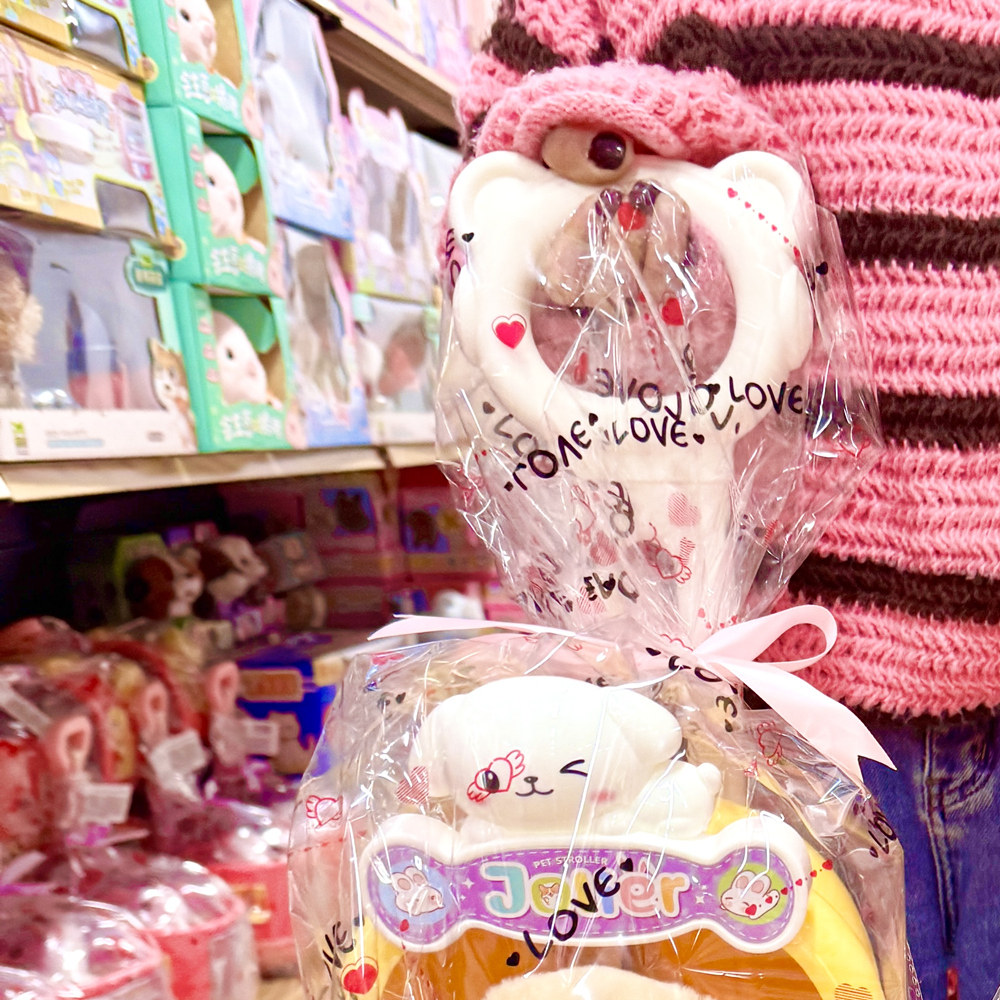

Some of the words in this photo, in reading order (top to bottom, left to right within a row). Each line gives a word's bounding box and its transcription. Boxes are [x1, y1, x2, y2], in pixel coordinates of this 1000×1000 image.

[729, 375, 805, 415] LOVE
[612, 416, 689, 448] LOVE
[533, 858, 551, 869] PET
[555, 855, 608, 866] STROLLER
[523, 866, 621, 960] LOVE
